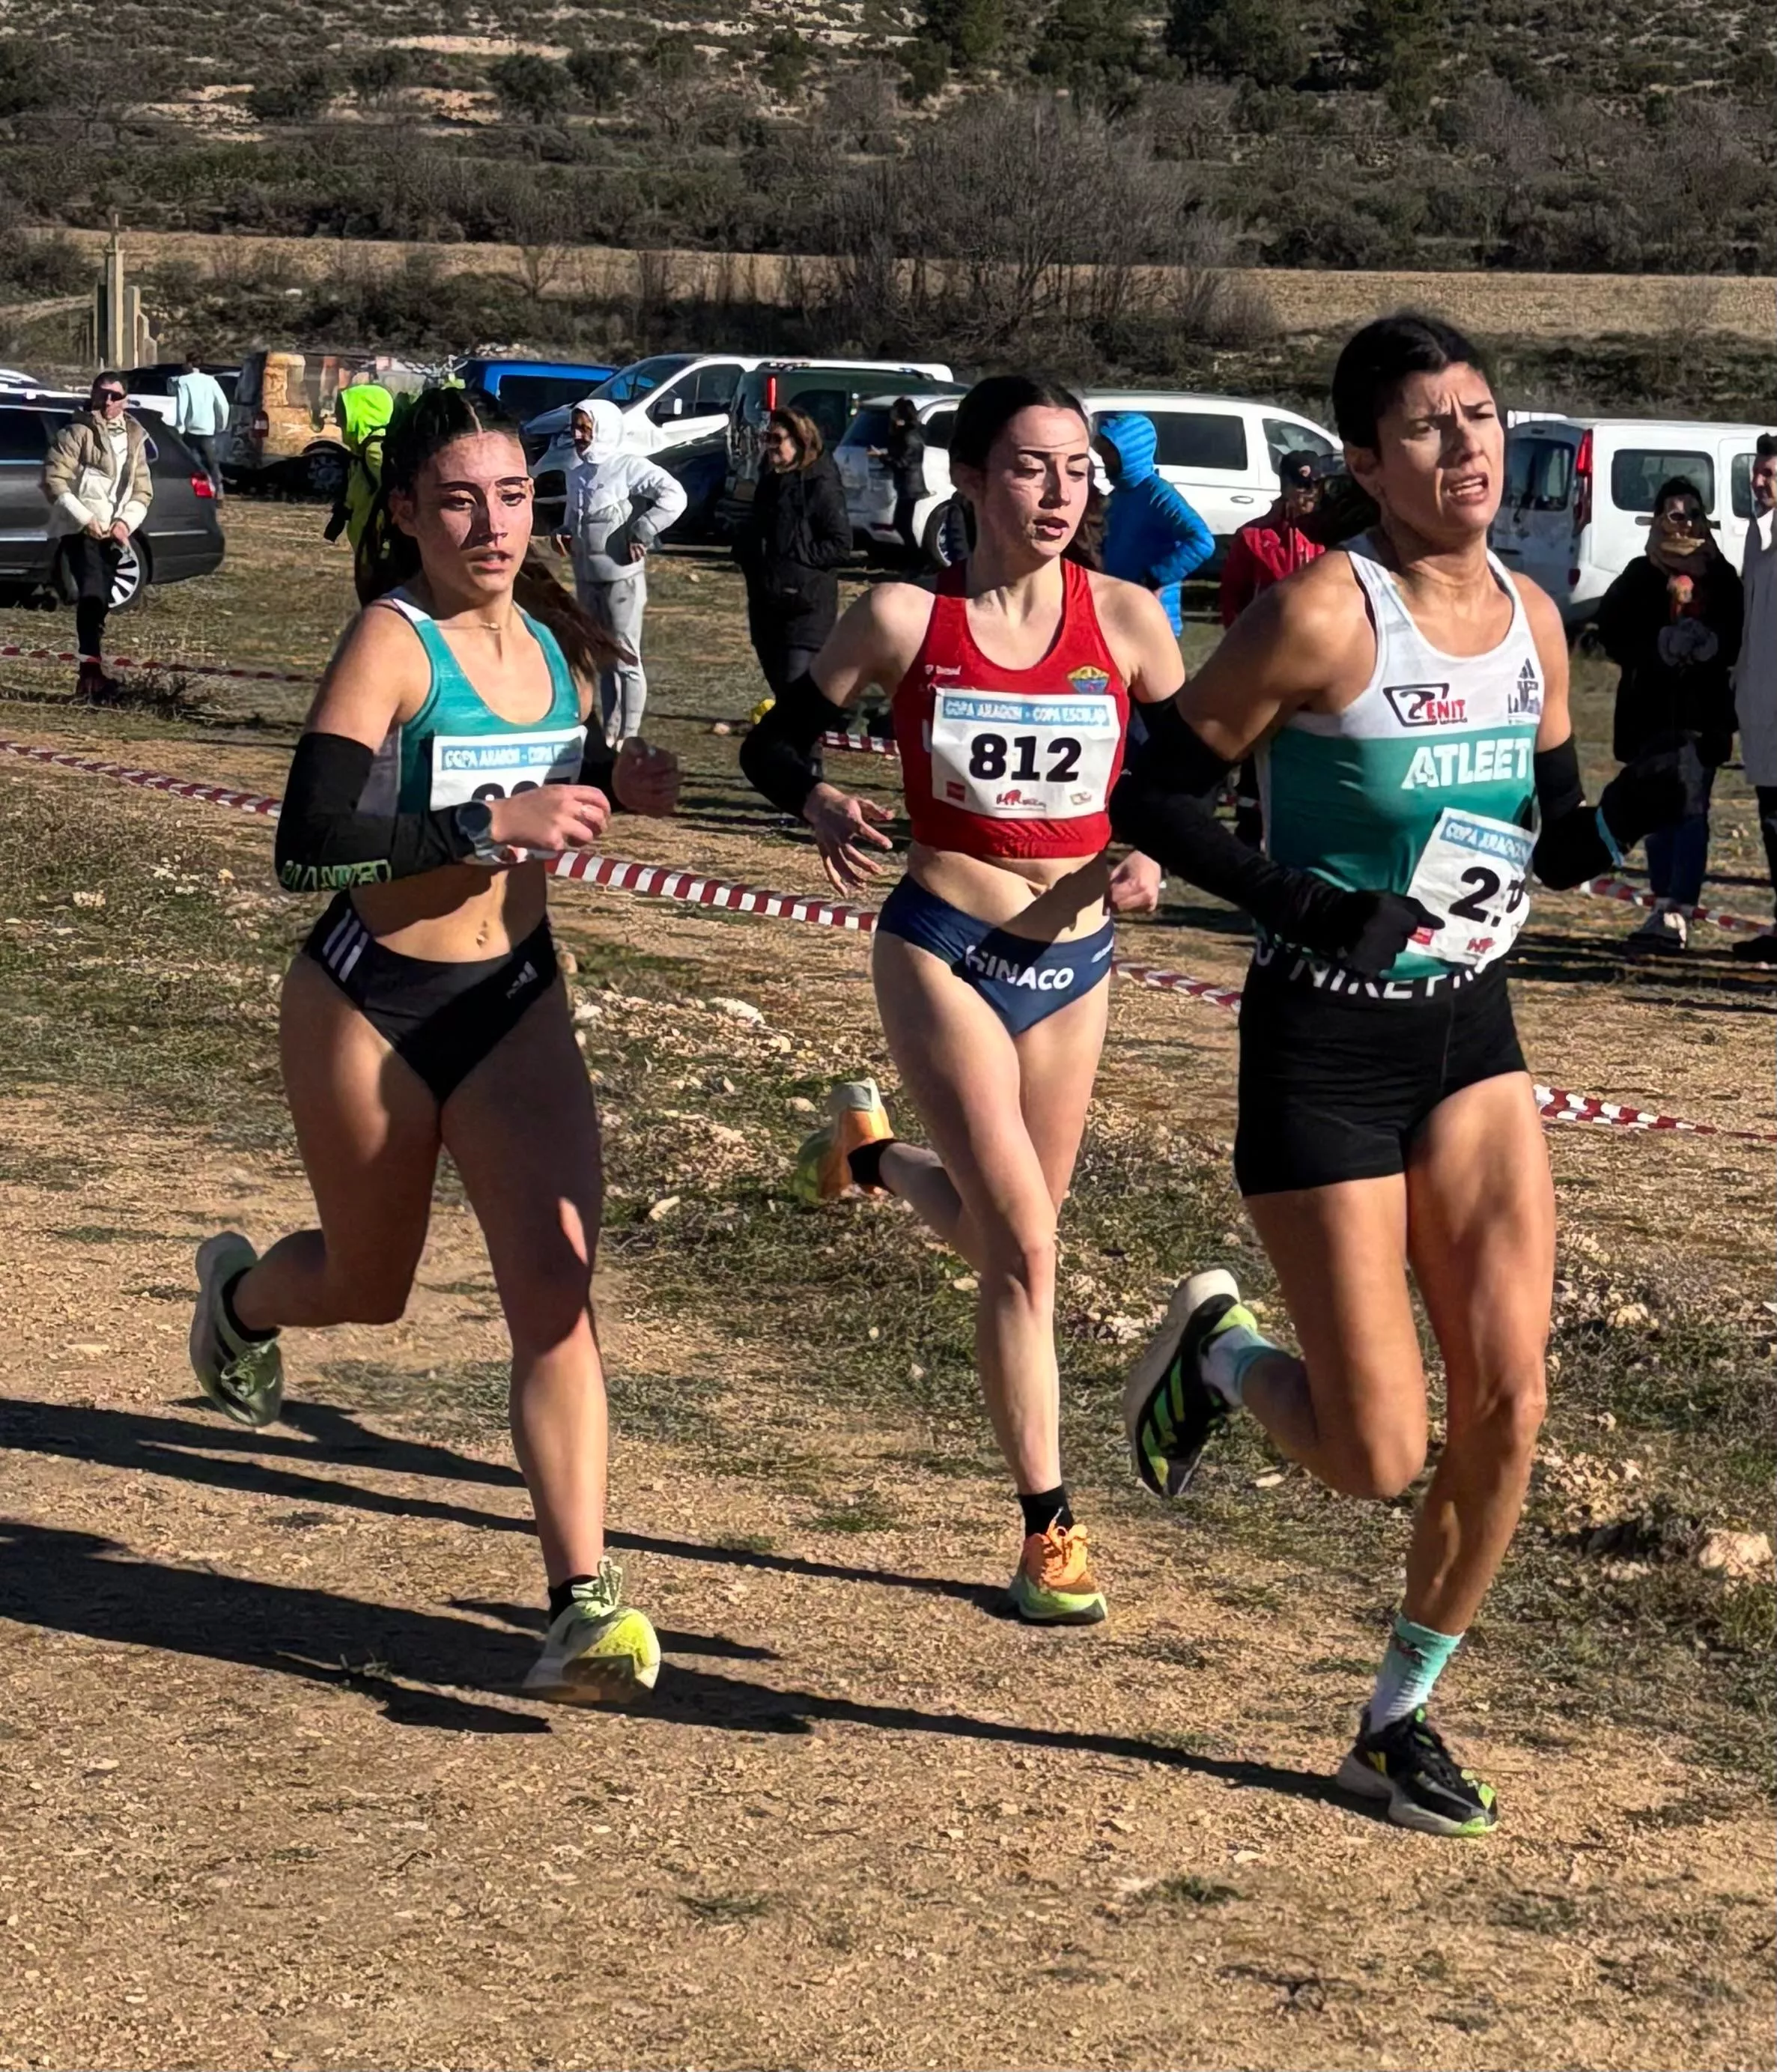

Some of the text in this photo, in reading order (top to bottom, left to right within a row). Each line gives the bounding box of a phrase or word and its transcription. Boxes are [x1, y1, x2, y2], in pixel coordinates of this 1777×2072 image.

[945, 699, 974, 717] COPA
[1399, 690, 1465, 720] ZENIT
[969, 733, 1081, 782] 812
